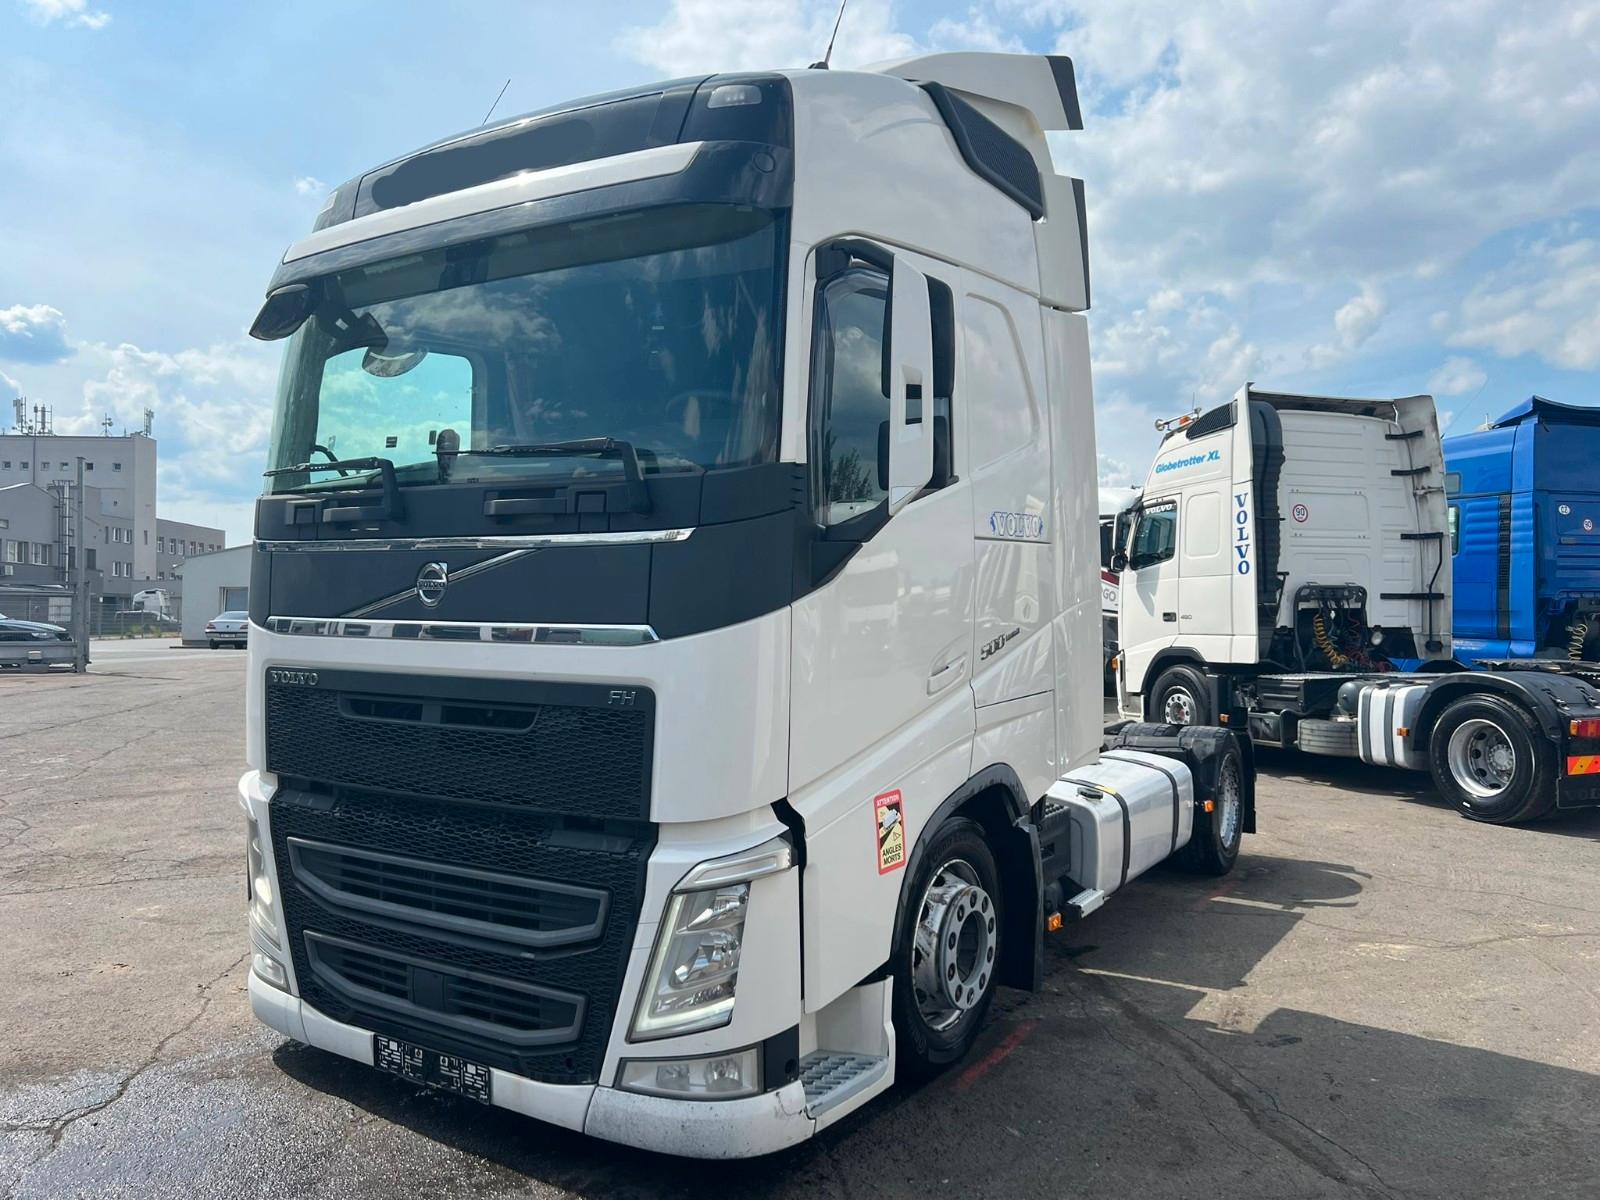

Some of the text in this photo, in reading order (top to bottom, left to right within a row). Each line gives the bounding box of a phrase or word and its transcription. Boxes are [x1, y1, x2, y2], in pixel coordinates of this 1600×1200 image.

[1155, 450, 1221, 474] Globetrotter XL
[1296, 507, 1305, 516] 90
[994, 512, 1040, 537] VOLVO
[1233, 493, 1251, 575] VOLVO
[270, 670, 319, 686] VOLVO
[608, 690, 637, 705] FH
[882, 843, 902, 857] ANGLES
[883, 852, 901, 865] MORTS
